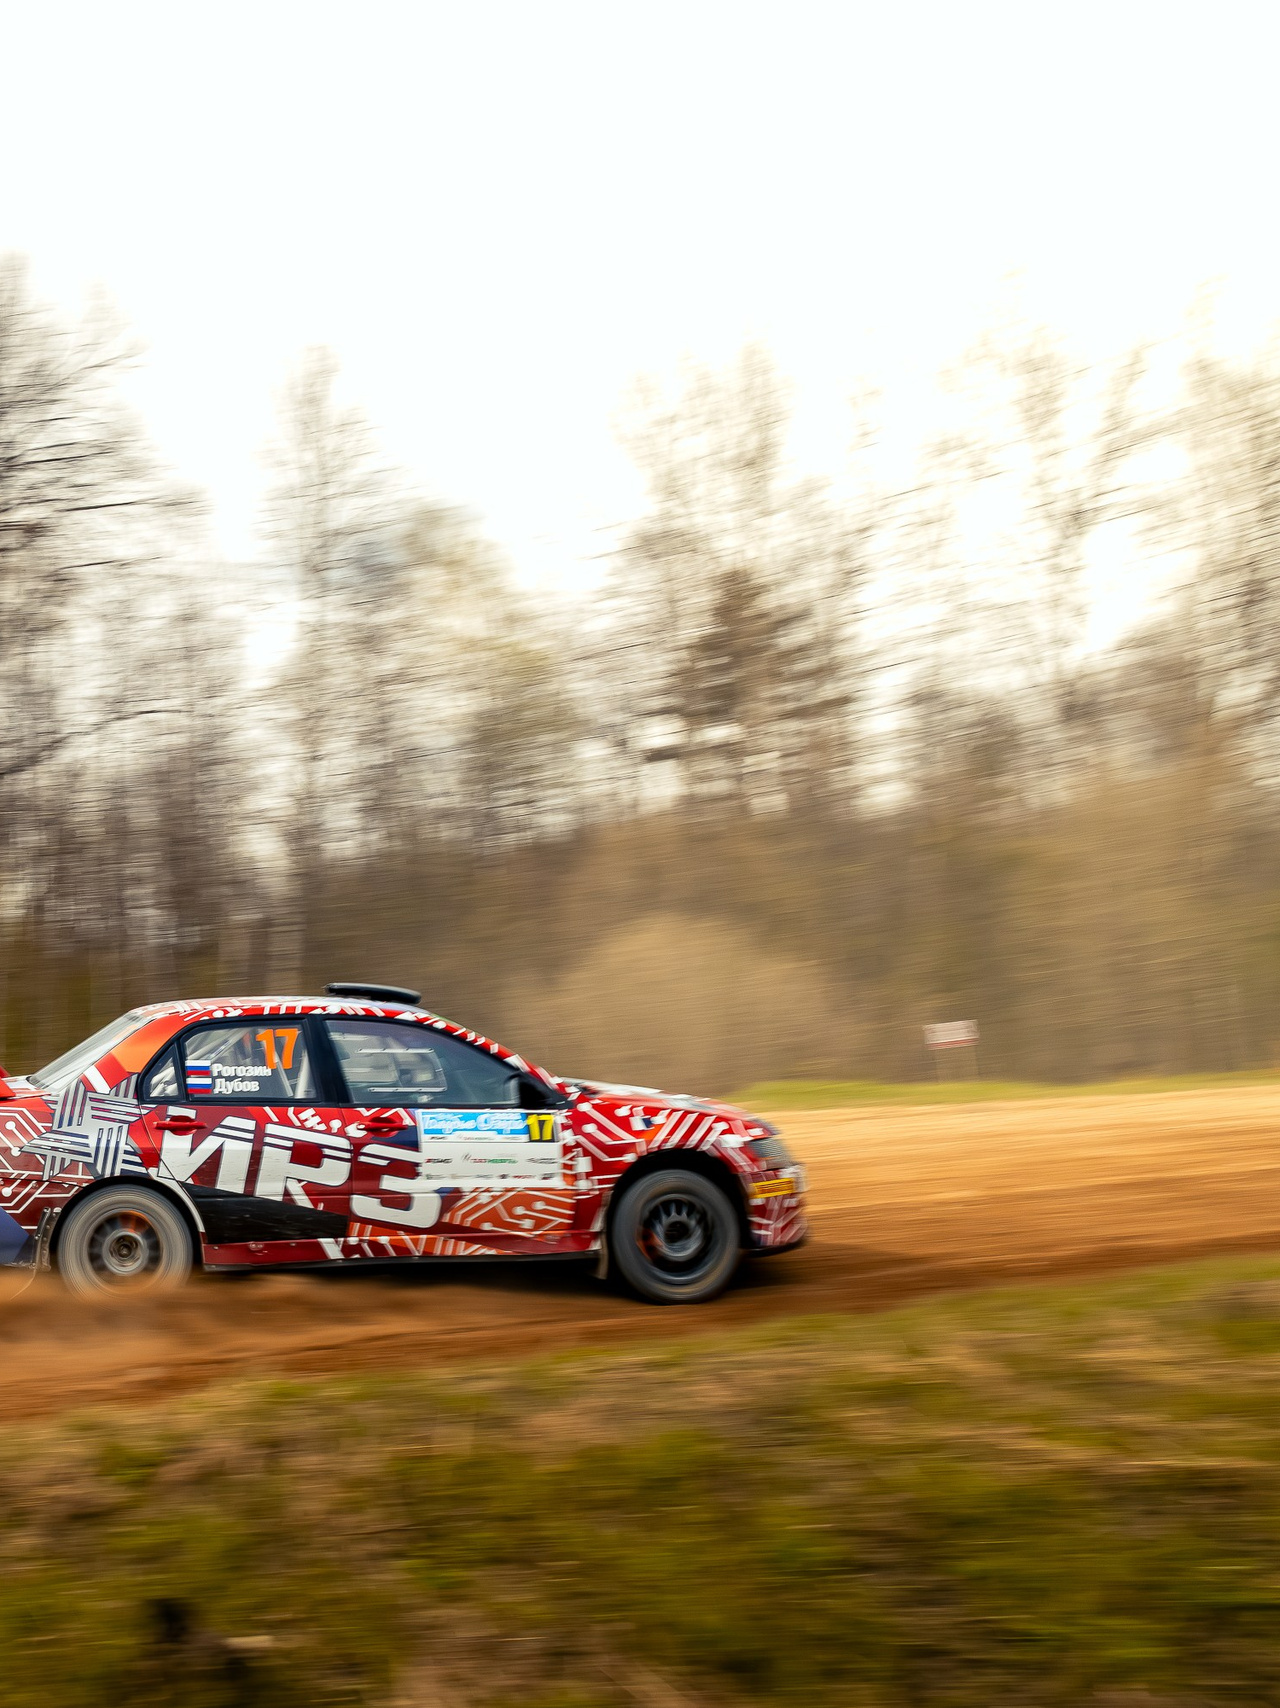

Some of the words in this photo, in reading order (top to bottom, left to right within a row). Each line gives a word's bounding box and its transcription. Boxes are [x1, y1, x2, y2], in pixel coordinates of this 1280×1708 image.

[255, 1028, 298, 1069] 17
[213, 1078, 260, 1094] Дубов
[527, 1114, 554, 1140] 17
